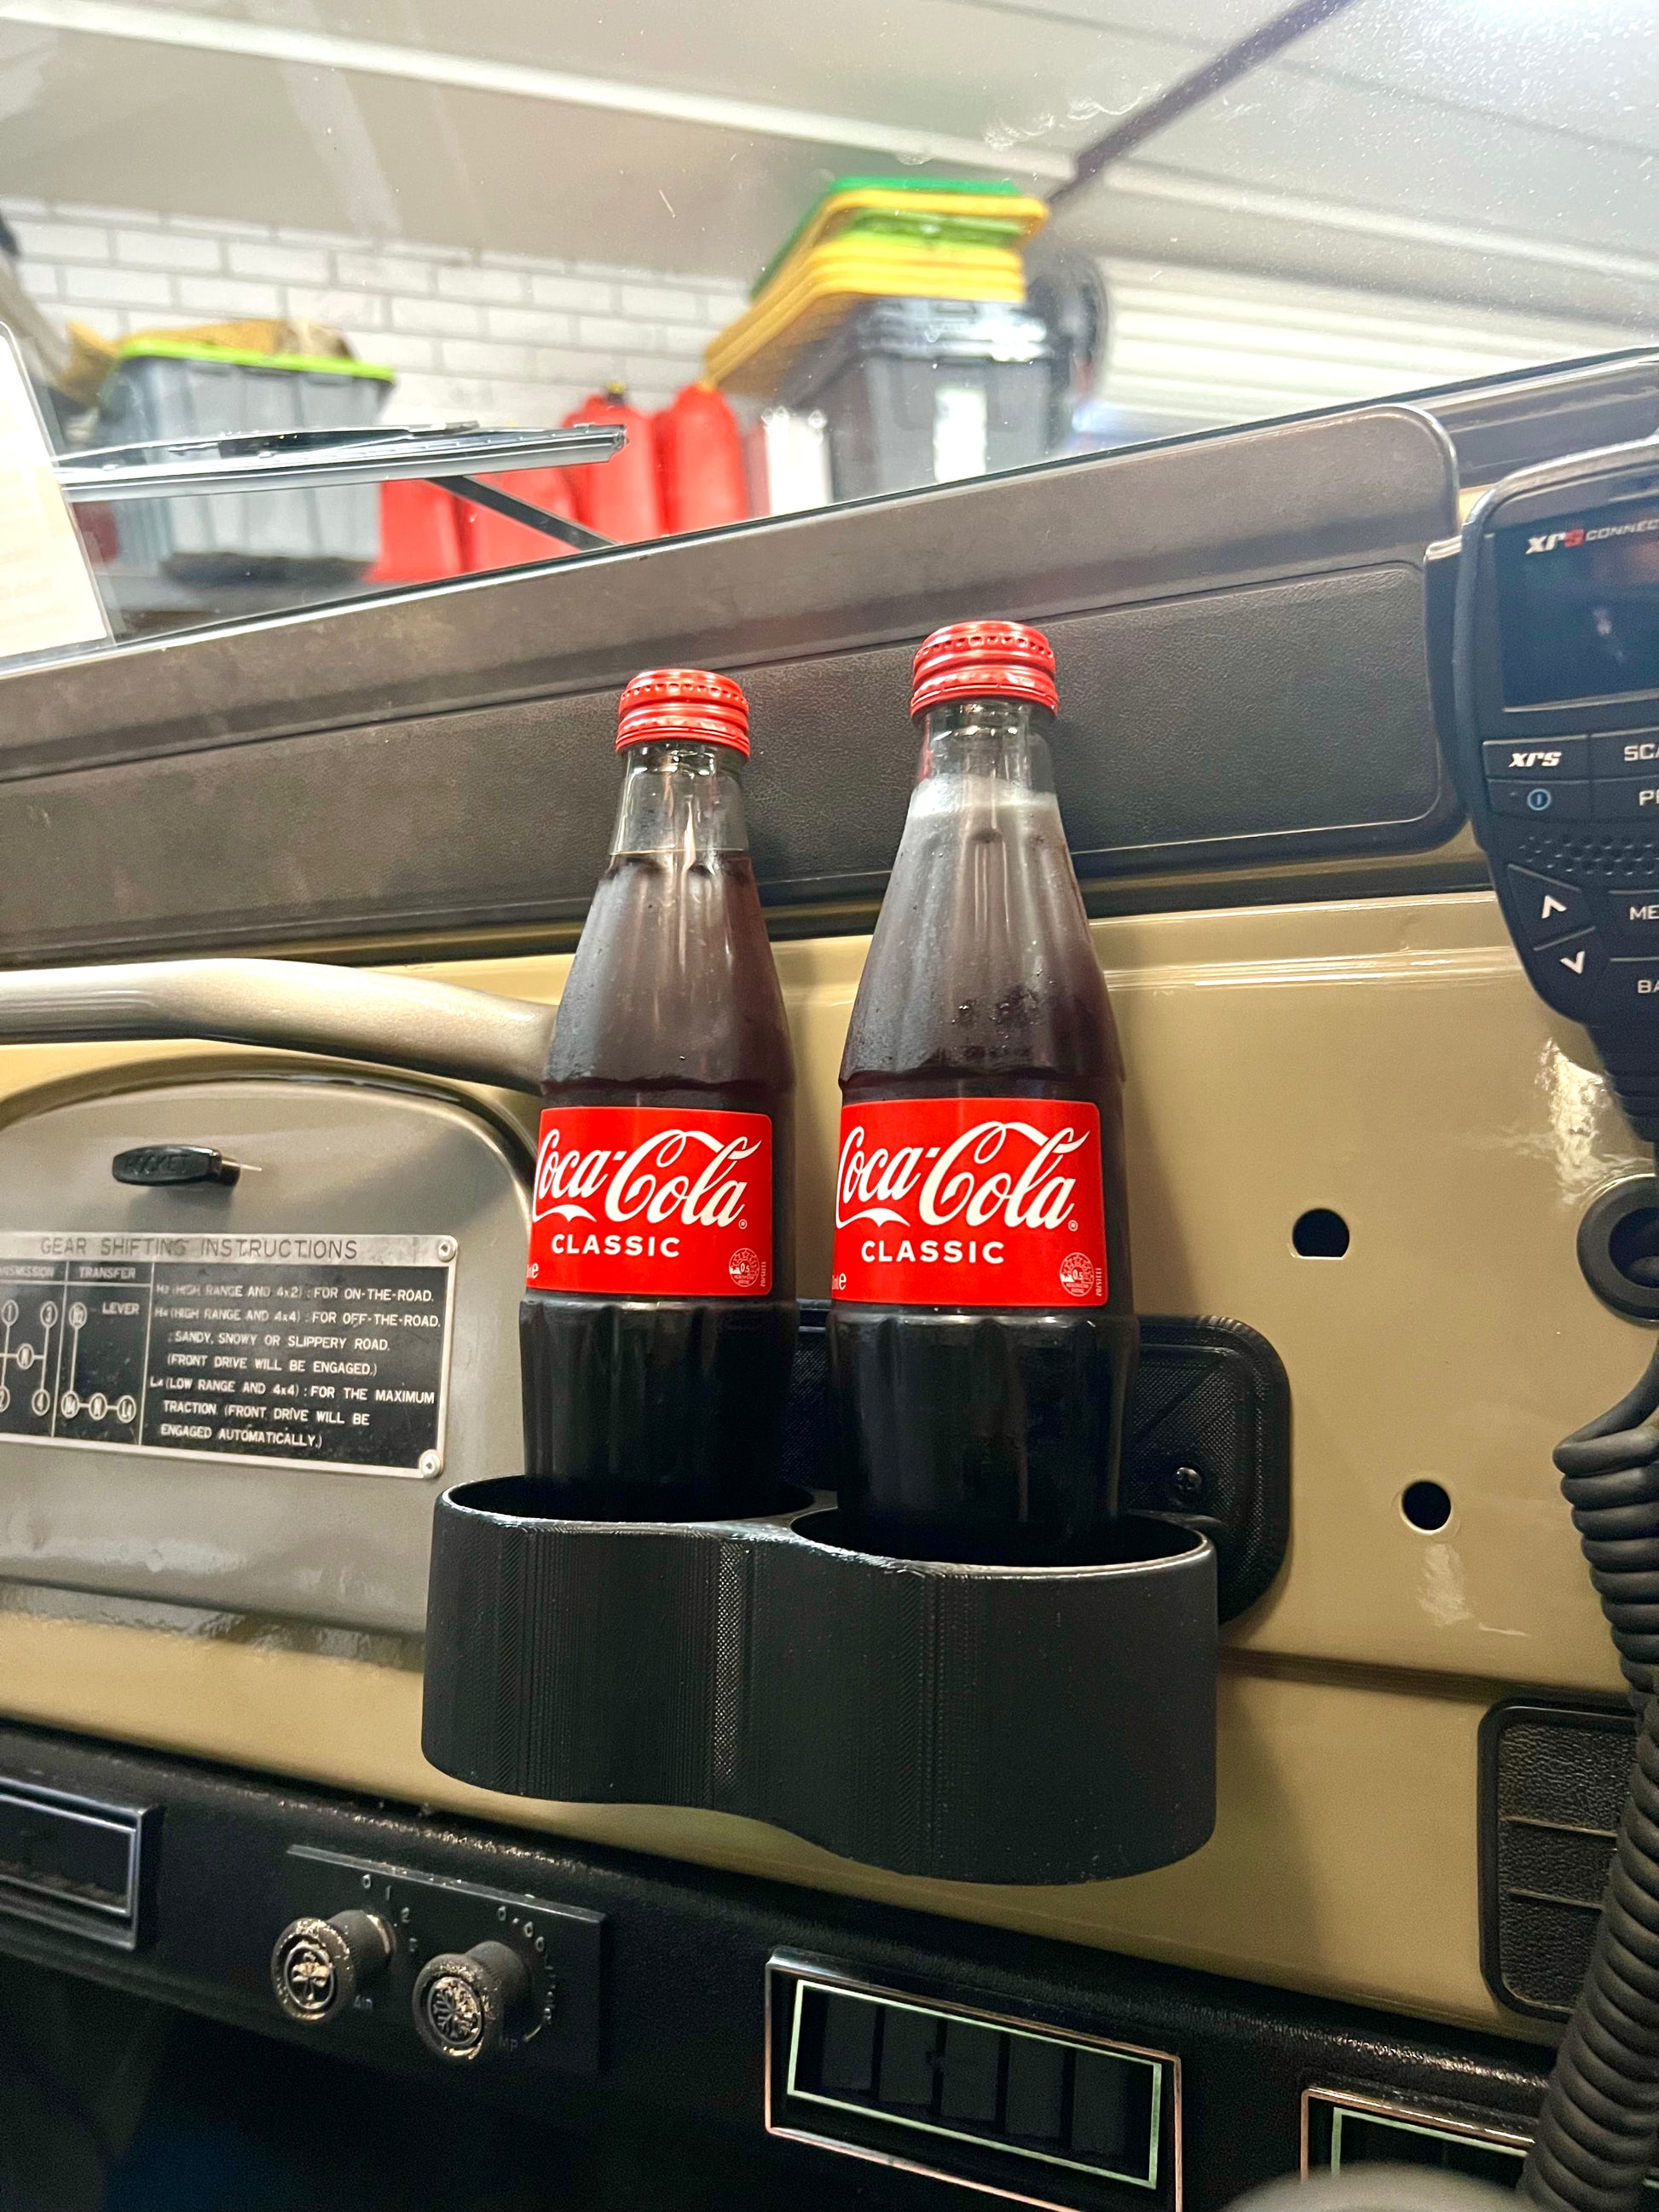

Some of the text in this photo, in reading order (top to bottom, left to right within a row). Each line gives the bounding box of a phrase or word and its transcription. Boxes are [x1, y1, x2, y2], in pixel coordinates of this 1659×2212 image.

[532, 1129, 762, 1227] Coca-Cola
[835, 1121, 1090, 1230] Coca-Cola
[41, 1238, 357, 1260] GEAR SHIFTING INSTRUCTIONS
[551, 1233, 680, 1257] CLASSIC
[860, 1239, 1005, 1264] CLASSIC
[79, 1267, 136, 1279] TRANSFER
[206, 1285, 243, 1297] RANGE
[248, 1285, 272, 1297] AND
[314, 1287, 338, 1299] FOR
[344, 1288, 435, 1302] ON-THE-ROAD.
[102, 1302, 140, 1315] LEVER
[204, 1308, 241, 1320] RANGE
[246, 1309, 269, 1321] AND
[312, 1311, 337, 1324] FOR
[343, 1313, 441, 1328] OFF-THE-ROAD.
[218, 1332, 257, 1345] SNOWY
[264, 1334, 280, 1346] OR
[288, 1336, 347, 1349] SLIPPERY
[354, 1338, 390, 1351] ROAD.
[167, 1353, 377, 1377] (FRONT DRIVE WILL BE ENGAGED.)
[165, 1377, 193, 1389] (LOW
[198, 1378, 235, 1393] RANGE
[241, 1381, 266, 1395] AND
[273, 1383, 299, 1398] 4x4)
[310, 1386, 335, 1399] FOR
[344, 1387, 367, 1401] THE
[375, 1389, 435, 1405] MAXIMUM
[163, 1400, 370, 1426] TRACTION (FRONT DRIVE WILL BE
[160, 1423, 322, 1448] ENGAGED AUTOMATICALLY.)
